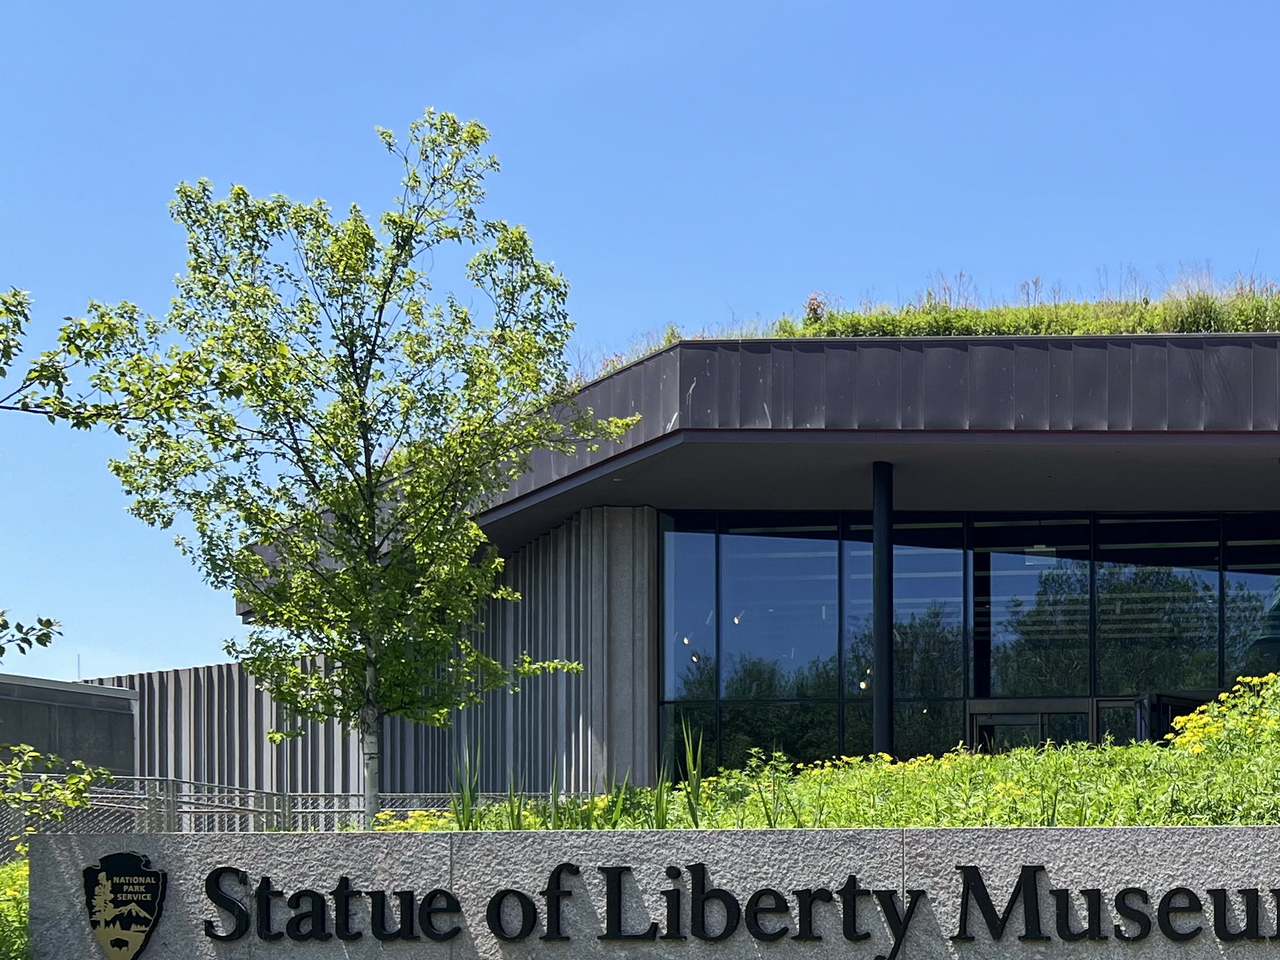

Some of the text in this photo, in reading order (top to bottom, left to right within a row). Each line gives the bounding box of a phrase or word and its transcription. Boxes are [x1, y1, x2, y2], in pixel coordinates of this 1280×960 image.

[113, 876, 156, 884] NATIONAL
[117, 893, 152, 901] SERVICE
[205, 866, 462, 941] Statue
[486, 863, 580, 941] of
